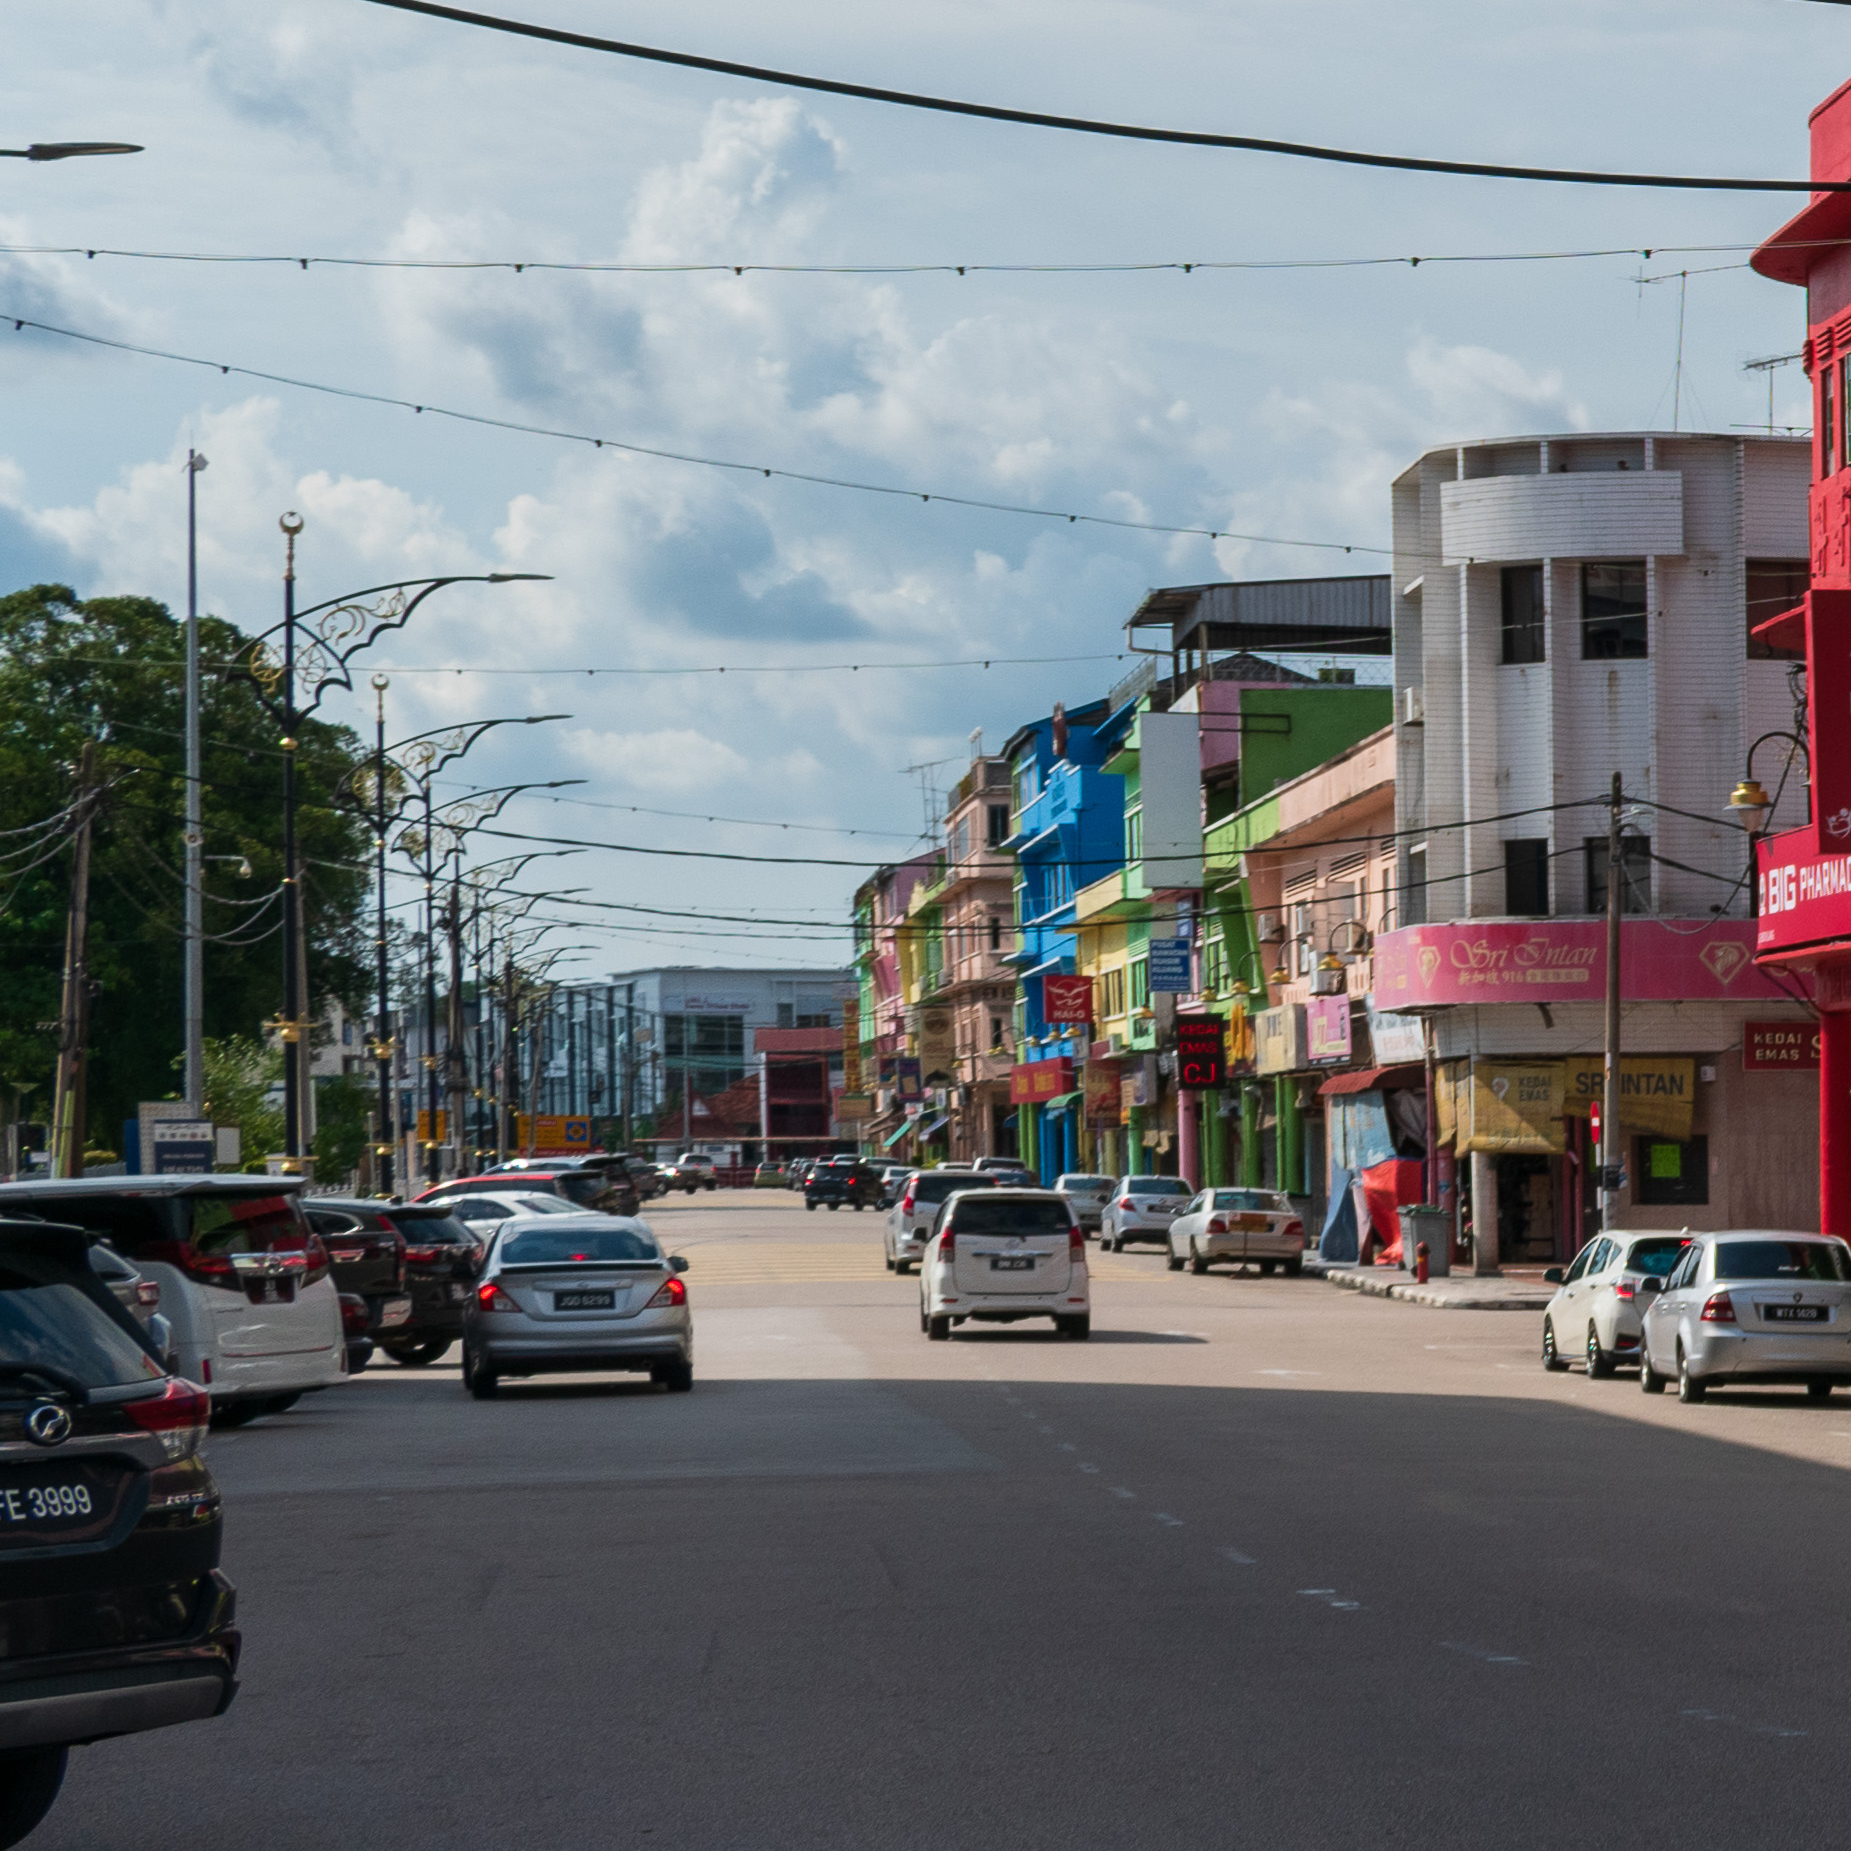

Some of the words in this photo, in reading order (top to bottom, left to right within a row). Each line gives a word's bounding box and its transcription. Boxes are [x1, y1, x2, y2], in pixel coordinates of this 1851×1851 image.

[1768, 864, 1797, 915] BIG
[1450, 939, 1511, 968] Sri
[1513, 937, 1599, 966] Intan
[1053, 1009, 1085, 1019] HAI-O
[1753, 1032, 1802, 1045] KEDAI
[1755, 1048, 1800, 1061] EMAS
[1183, 1061, 1217, 1084] CJ
[1518, 1076, 1551, 1087] KEDAI
[1620, 1073, 1685, 1096] INTAN
[1518, 1089, 1550, 1101] EMAS
[27, 1483, 93, 1517] 3999
